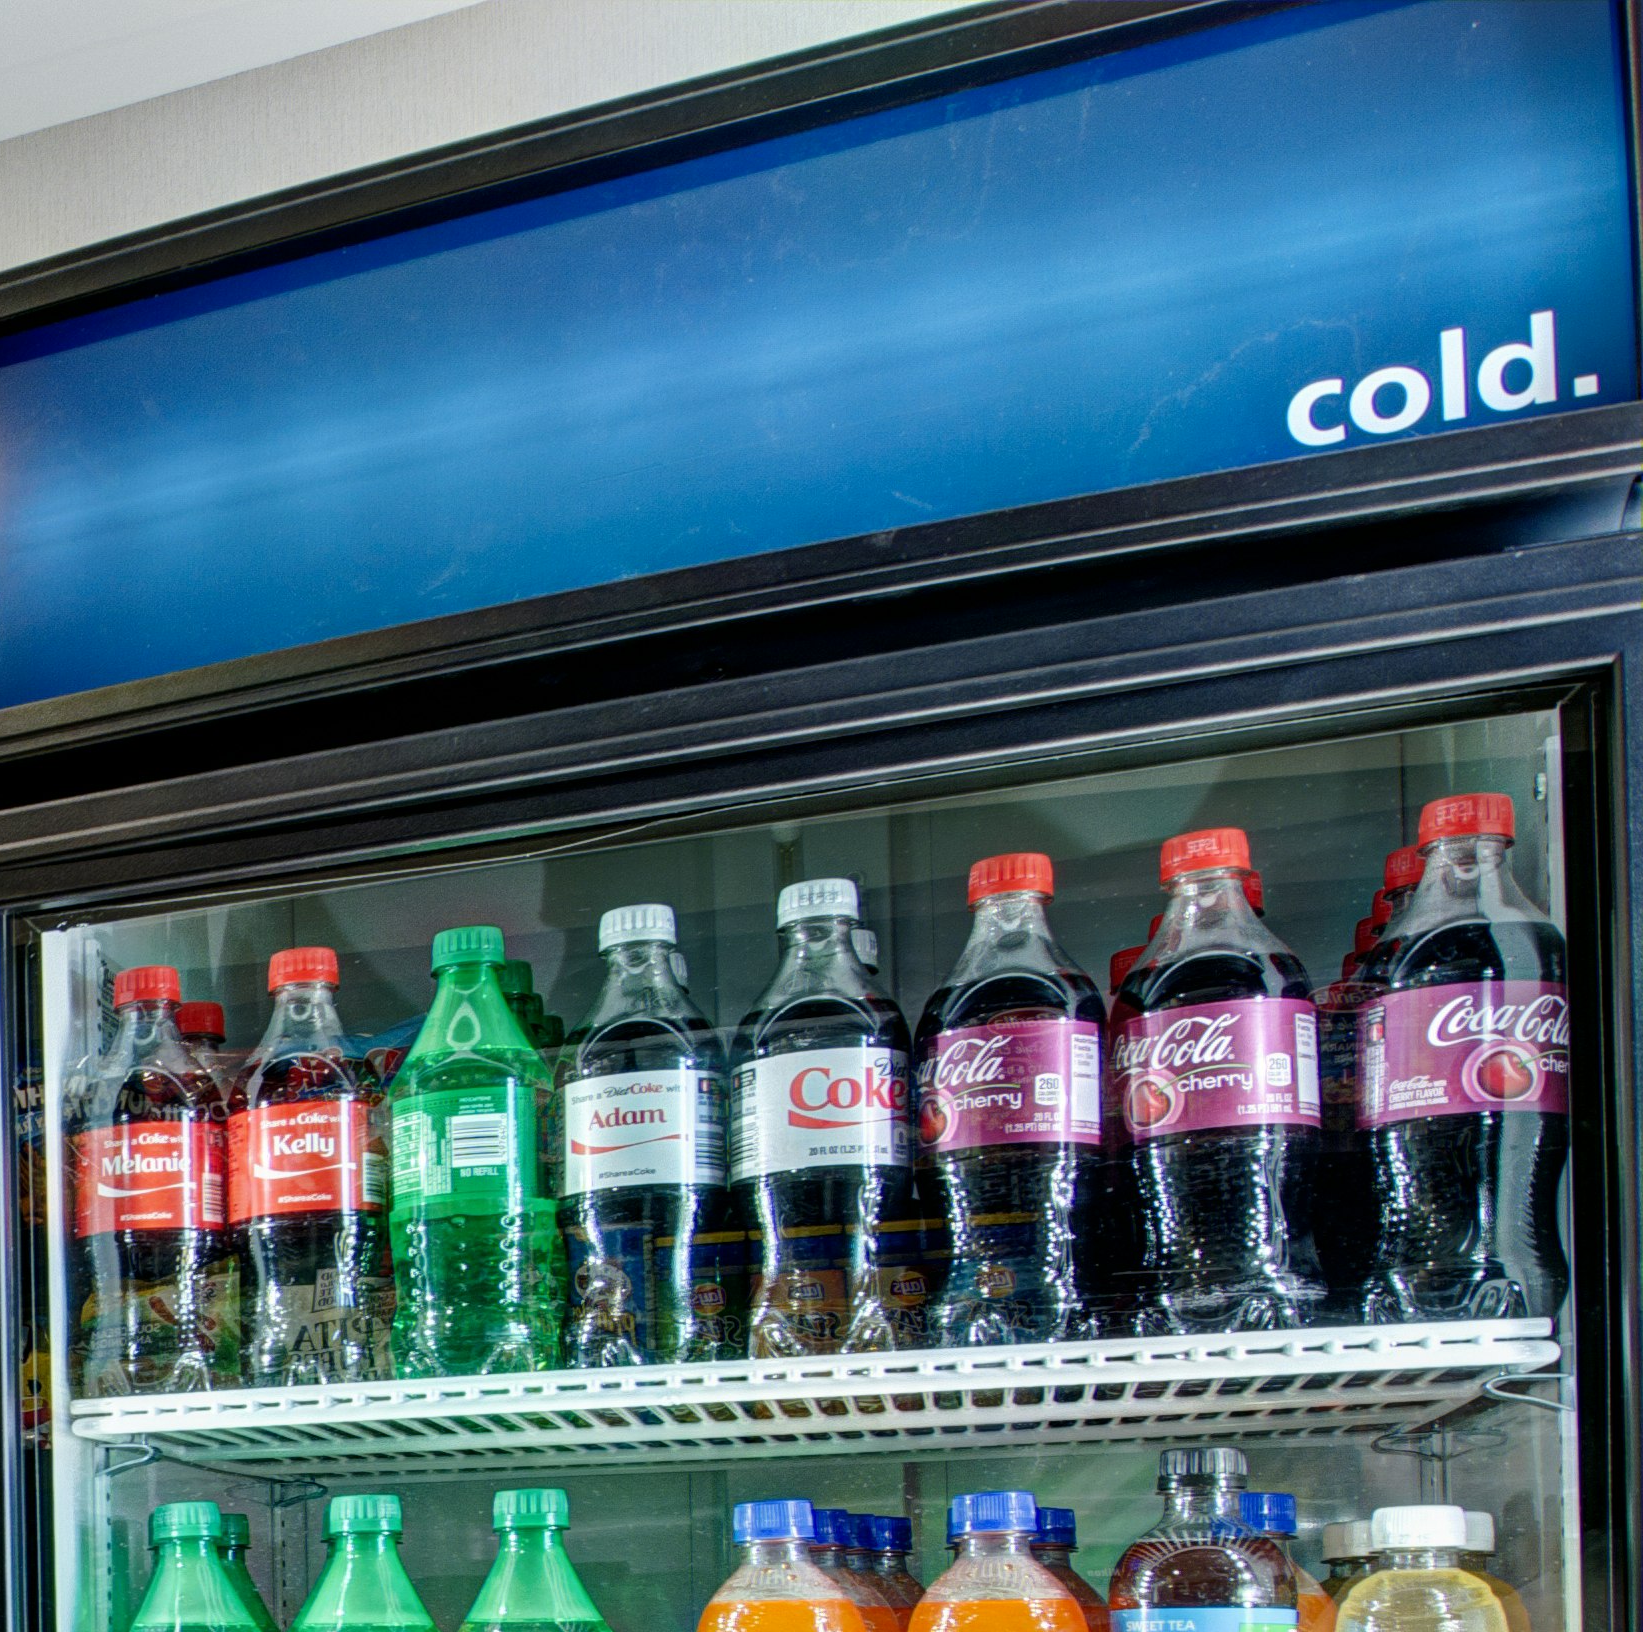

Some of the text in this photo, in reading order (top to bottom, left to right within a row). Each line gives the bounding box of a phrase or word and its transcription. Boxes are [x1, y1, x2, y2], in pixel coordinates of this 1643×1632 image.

[1286, 309, 1600, 447] cold.
[1268, 1057, 1288, 1071] 260
[630, 1082, 664, 1095] Coke
[789, 1066, 907, 1112] Coke
[1038, 1077, 1060, 1090] 260
[1176, 1072, 1254, 1093] cherry
[952, 1091, 1023, 1112] cherry
[296, 1112, 330, 1125] Coke
[588, 1106, 668, 1131] Adam
[272, 1132, 335, 1158] Kelly
[101, 1150, 192, 1177] Melanie
[598, 1167, 657, 1180] #ShareaCoke
[1125, 1619, 1196, 1632] SWEET TEA
